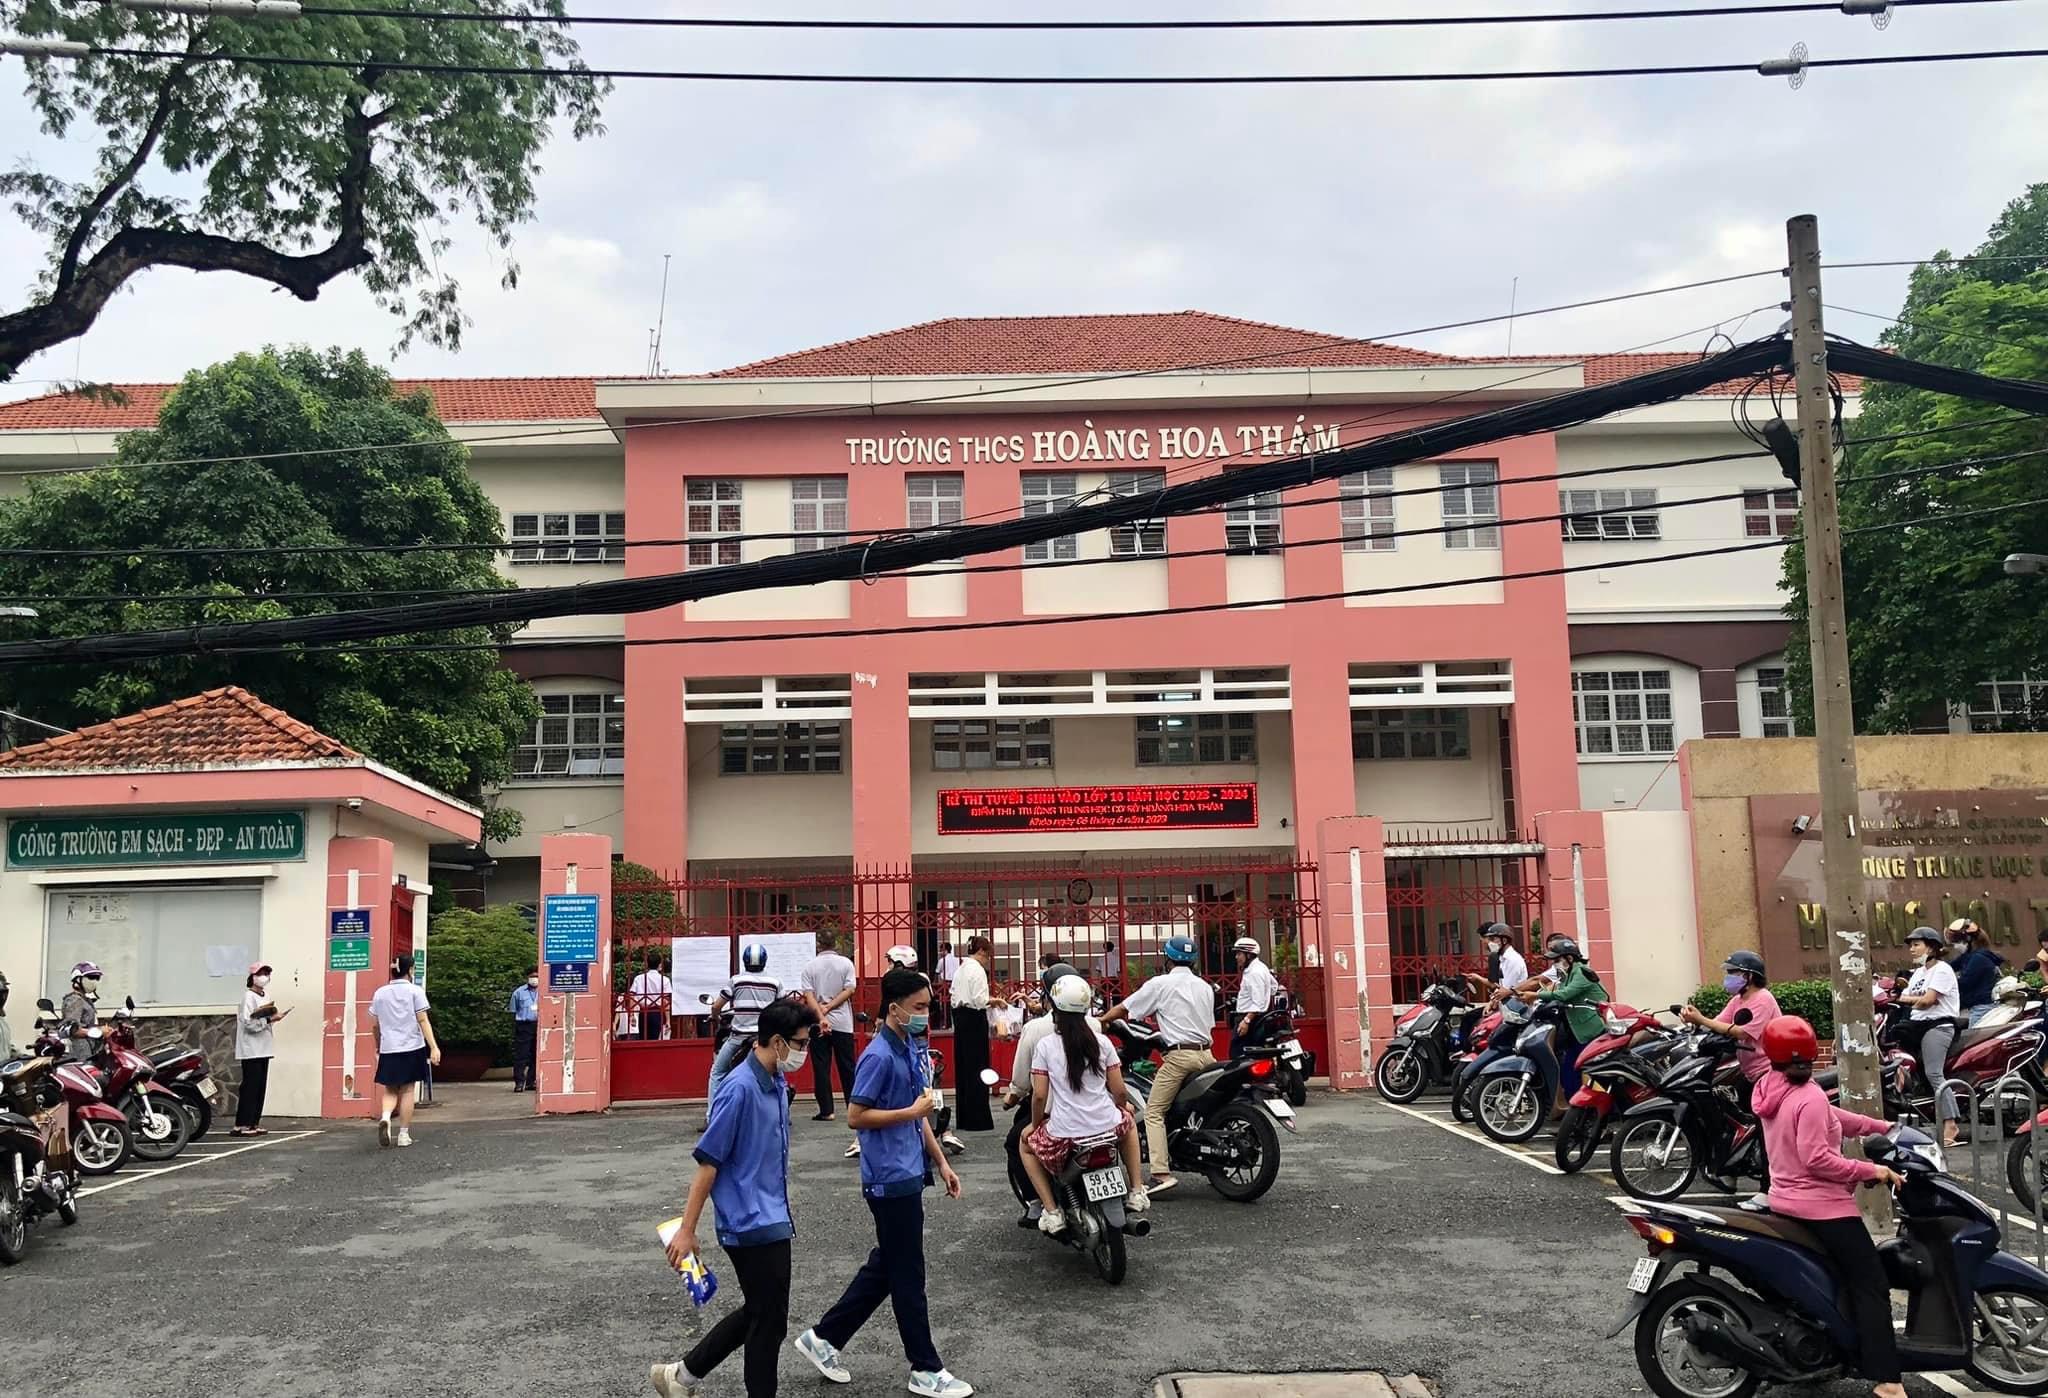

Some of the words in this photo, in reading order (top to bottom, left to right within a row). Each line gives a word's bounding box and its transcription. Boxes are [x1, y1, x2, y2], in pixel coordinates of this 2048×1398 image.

[845, 431, 953, 465] TRƯỜNG
[960, 435, 1026, 463] THCS
[1031, 419, 1151, 464] HOÀNG
[1158, 427, 1231, 460] HOA
[1235, 414, 1343, 457] THÁM
[962, 794, 983, 805] THI
[1026, 792, 1056, 804] SINH
[1058, 790, 1081, 803] VÀO
[1110, 790, 1124, 801] 10
[1220, 787, 1248, 799] 2024
[17, 823, 57, 858] CỔNG
[60, 826, 117, 857] TRƯỜNG
[120, 829, 142, 855] EM
[146, 828, 184, 857] SẠCH
[196, 827, 224, 856] ĐẸP
[236, 826, 255, 850] AN
[258, 819, 296, 849] TOÀN
[1913, 856, 1985, 881] TRUNG
[1990, 856, 2034, 884] HỌC
[1089, 1171, 1116, 1185] 59-K1
[1090, 1183, 1123, 1199] 348.55
